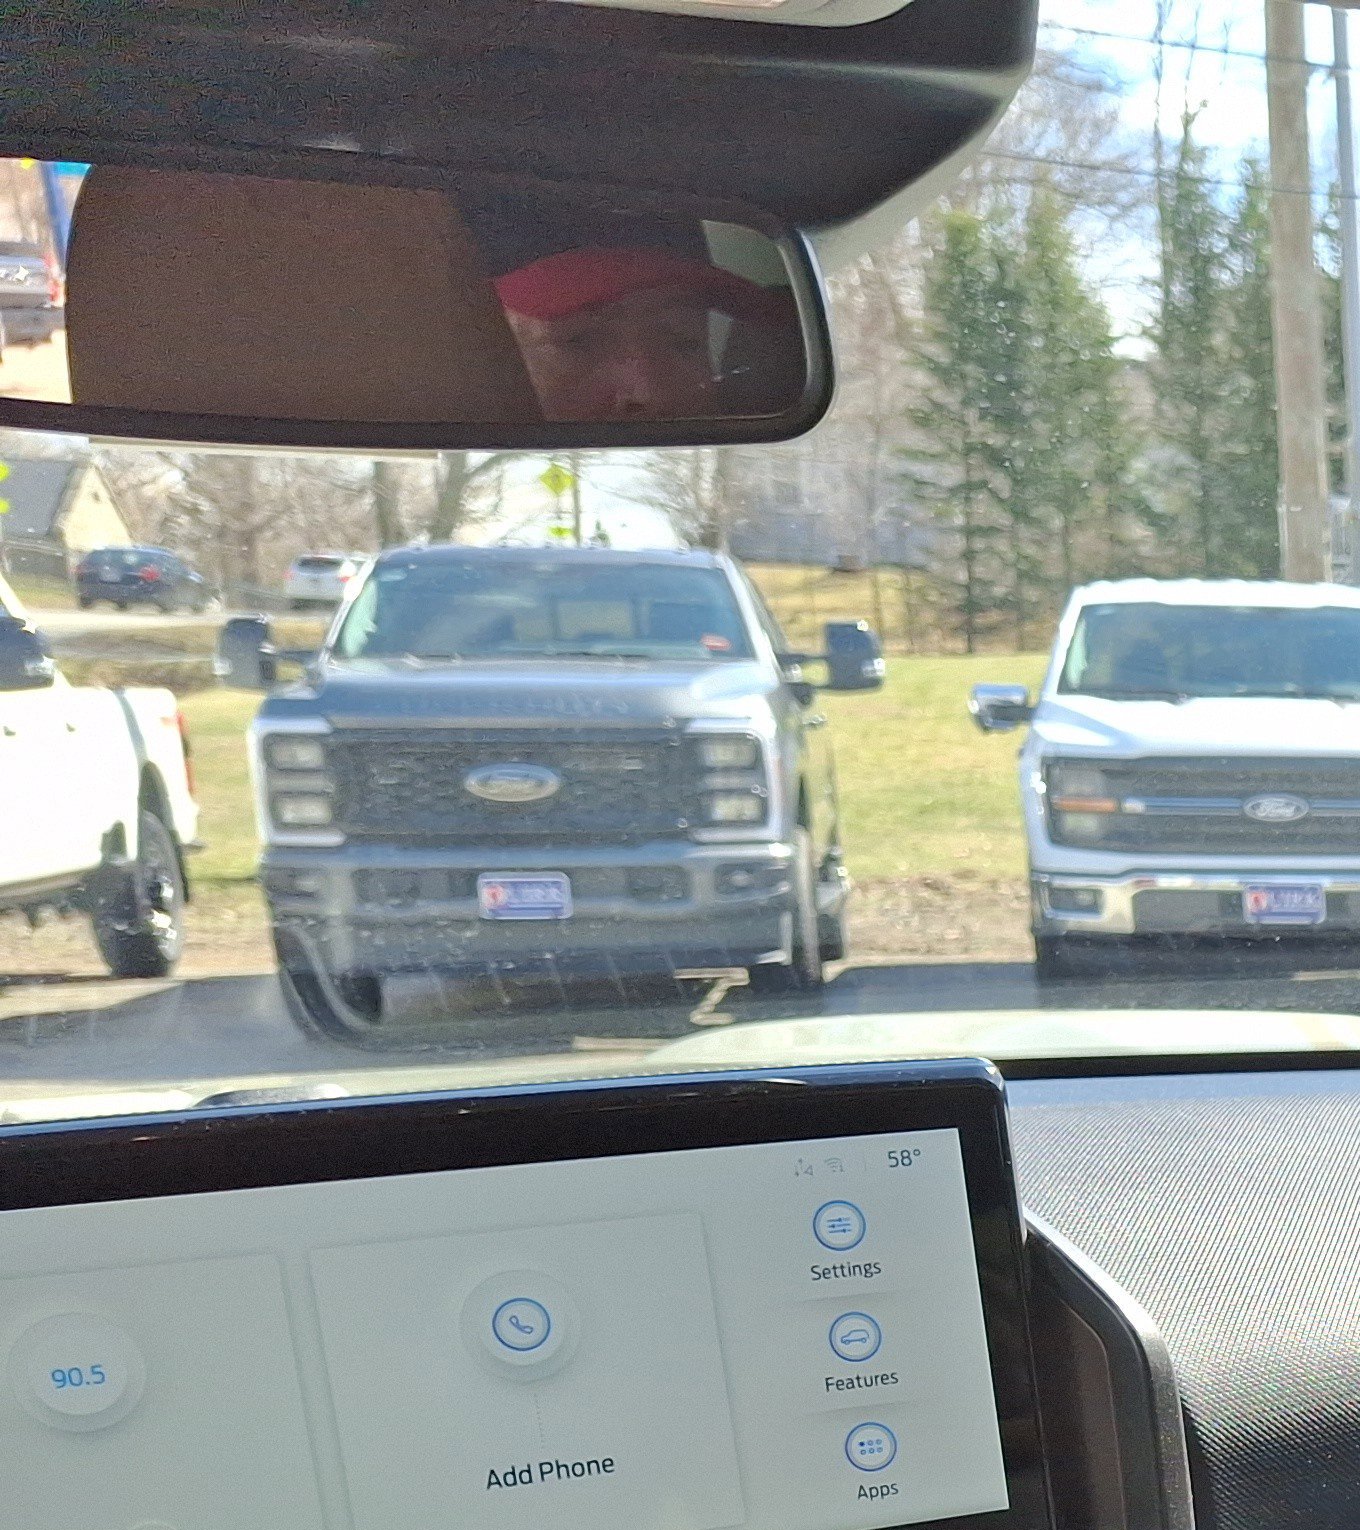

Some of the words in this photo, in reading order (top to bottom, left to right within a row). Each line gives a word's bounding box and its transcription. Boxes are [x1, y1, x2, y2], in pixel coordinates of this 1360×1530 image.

[887, 1149, 921, 1168] 58°
[811, 1261, 882, 1281] Settings
[52, 1364, 105, 1389] 90.5
[825, 1371, 899, 1392] Features
[486, 1463, 533, 1490] Add
[539, 1457, 615, 1482] Phone
[857, 1483, 899, 1501] Apps
